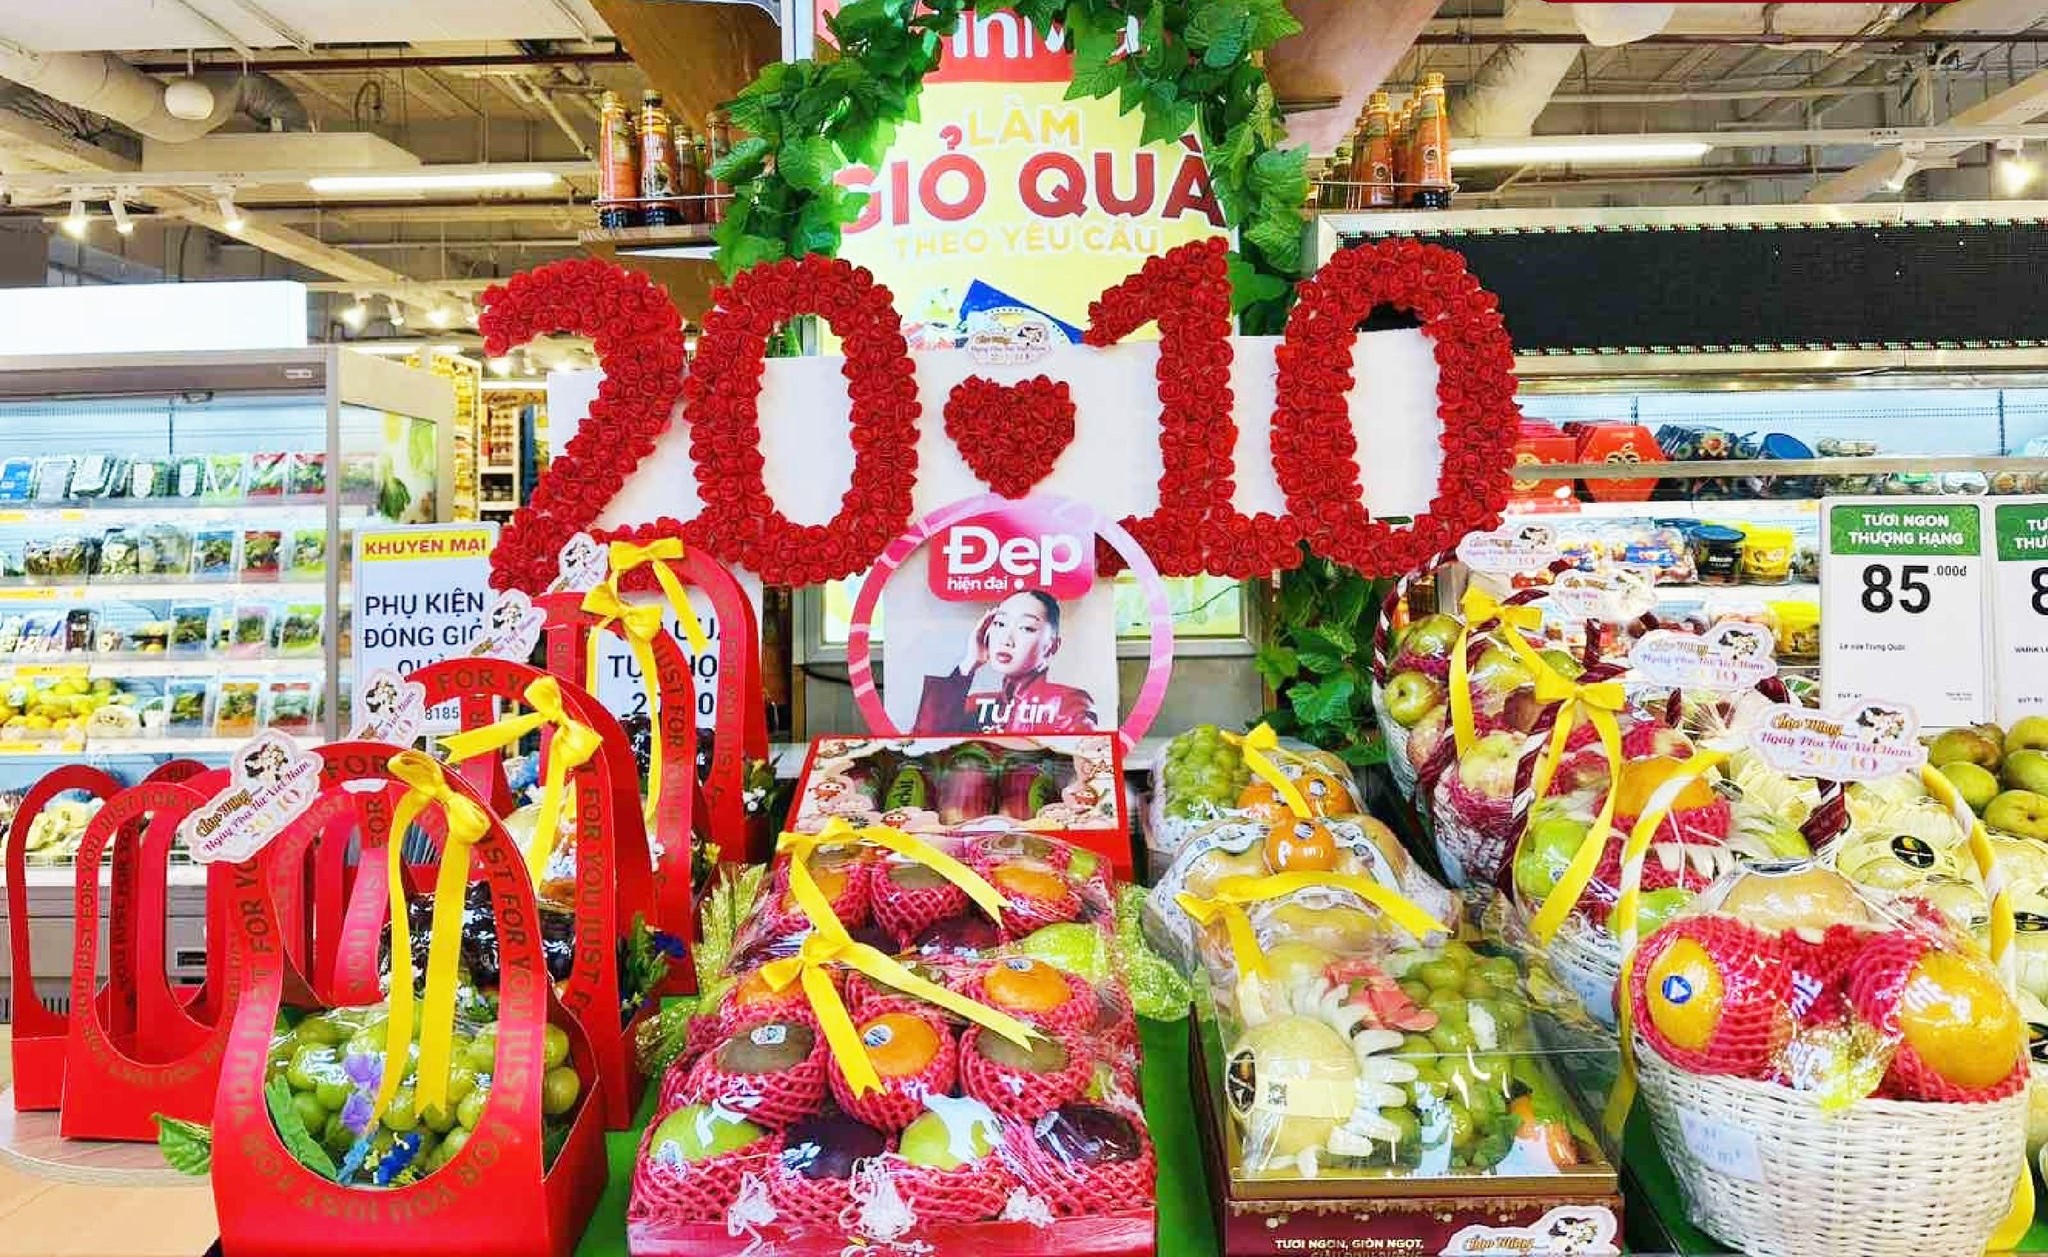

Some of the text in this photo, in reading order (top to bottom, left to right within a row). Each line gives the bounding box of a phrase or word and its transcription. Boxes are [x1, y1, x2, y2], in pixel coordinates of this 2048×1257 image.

[1018, 134, 1228, 228] QUÀ
[893, 229, 989, 257] THEO
[1002, 222, 1070, 252] YÊU
[1084, 237, 1521, 580] 10
[1862, 513, 1949, 528] TƯƠI NGON
[1848, 530, 1964, 548] THƯỢNG HẠNG
[942, 525, 1083, 589] Đẹp
[947, 576, 1008, 594] hiện đại
[1861, 564, 1931, 614] 85
[365, 587, 484, 619] PHỤ KIỆN
[364, 622, 434, 648] ĐÓNG
[238, 896, 273, 955] FOR
[499, 892, 528, 947] FOR
